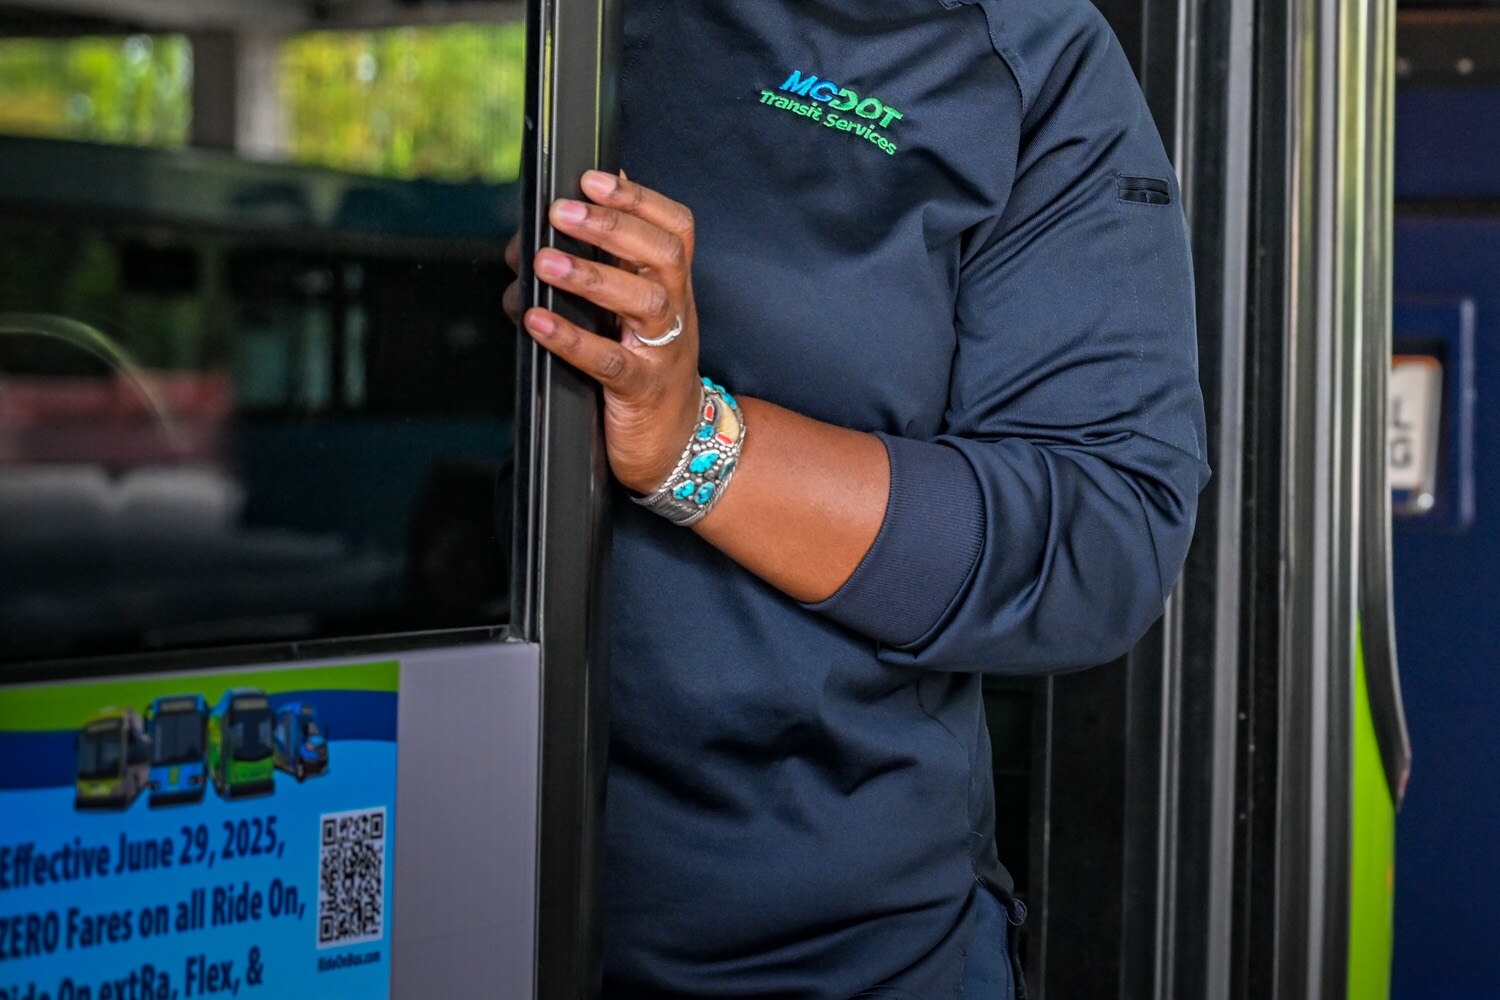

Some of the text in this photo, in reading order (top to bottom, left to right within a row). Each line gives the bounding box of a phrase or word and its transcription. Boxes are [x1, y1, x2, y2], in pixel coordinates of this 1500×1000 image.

[759, 89, 898, 156] Transit Services
[778, 70, 904, 129] MCDOT
[0, 815, 286, 889] Effective June 29, 2025,
[0, 876, 306, 961] ZERO Fares on all Ride On,
[185, 954, 241, 998] Flex,
[246, 945, 265, 987] &
